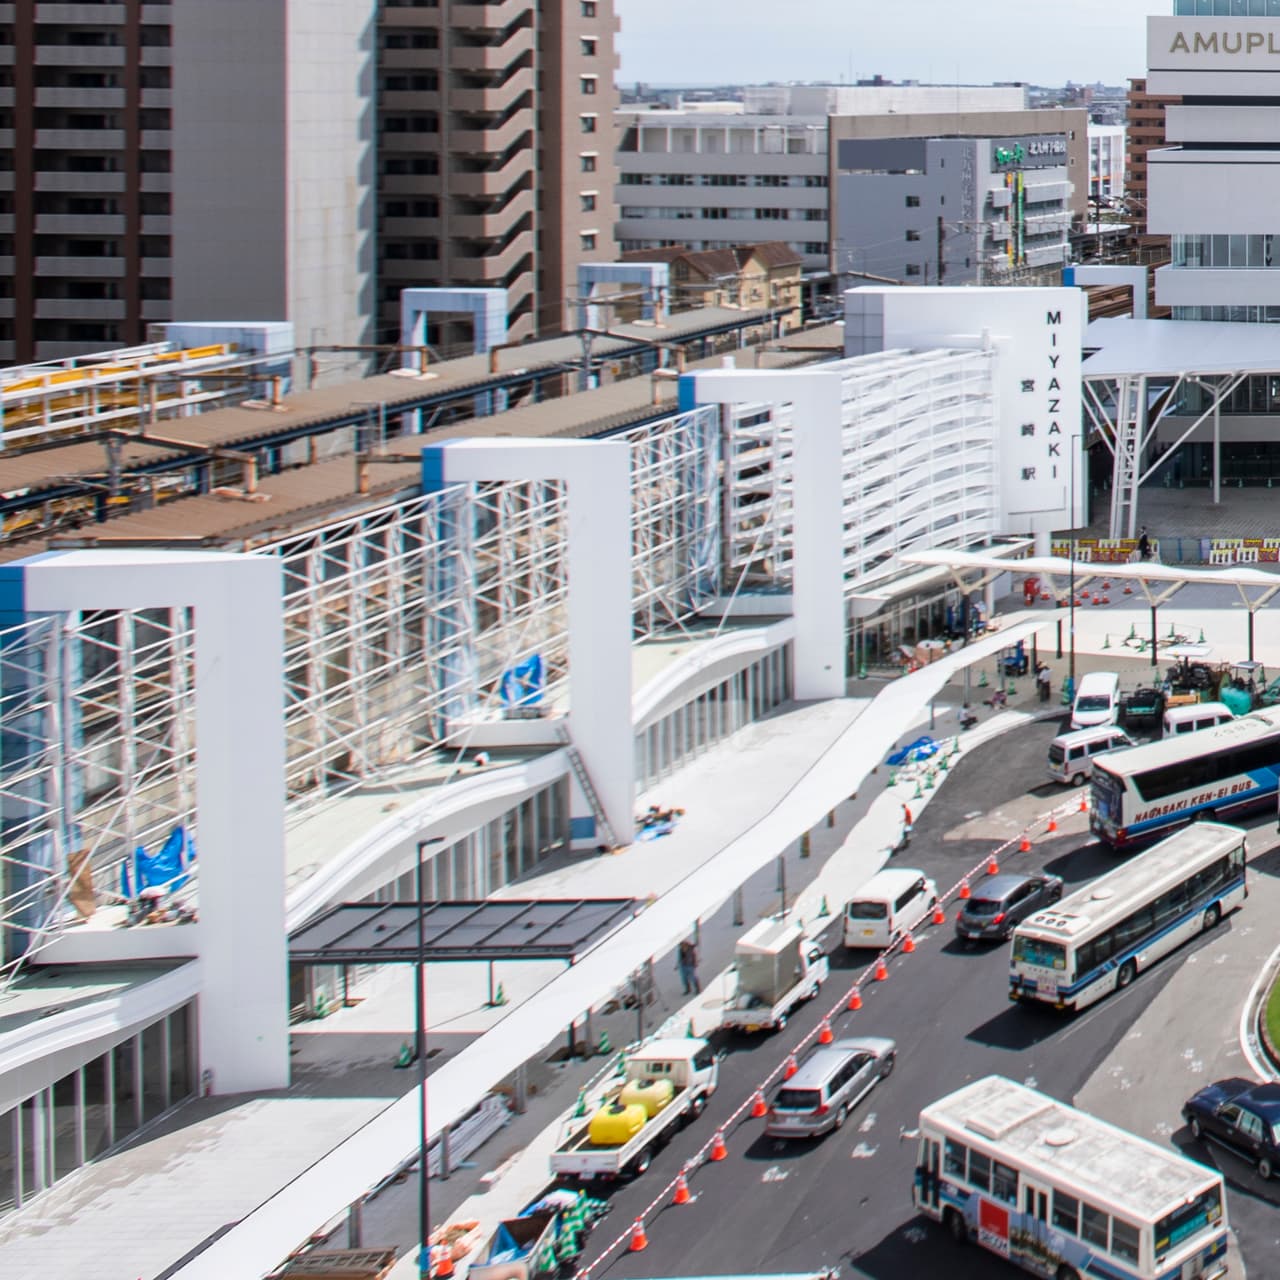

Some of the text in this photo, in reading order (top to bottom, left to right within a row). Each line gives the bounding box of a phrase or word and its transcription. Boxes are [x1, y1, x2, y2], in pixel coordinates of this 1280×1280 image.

[1046, 311, 1061, 480] MIYAZAKI
[1134, 780, 1253, 822] NAGASAKI KEN-EI BUS
